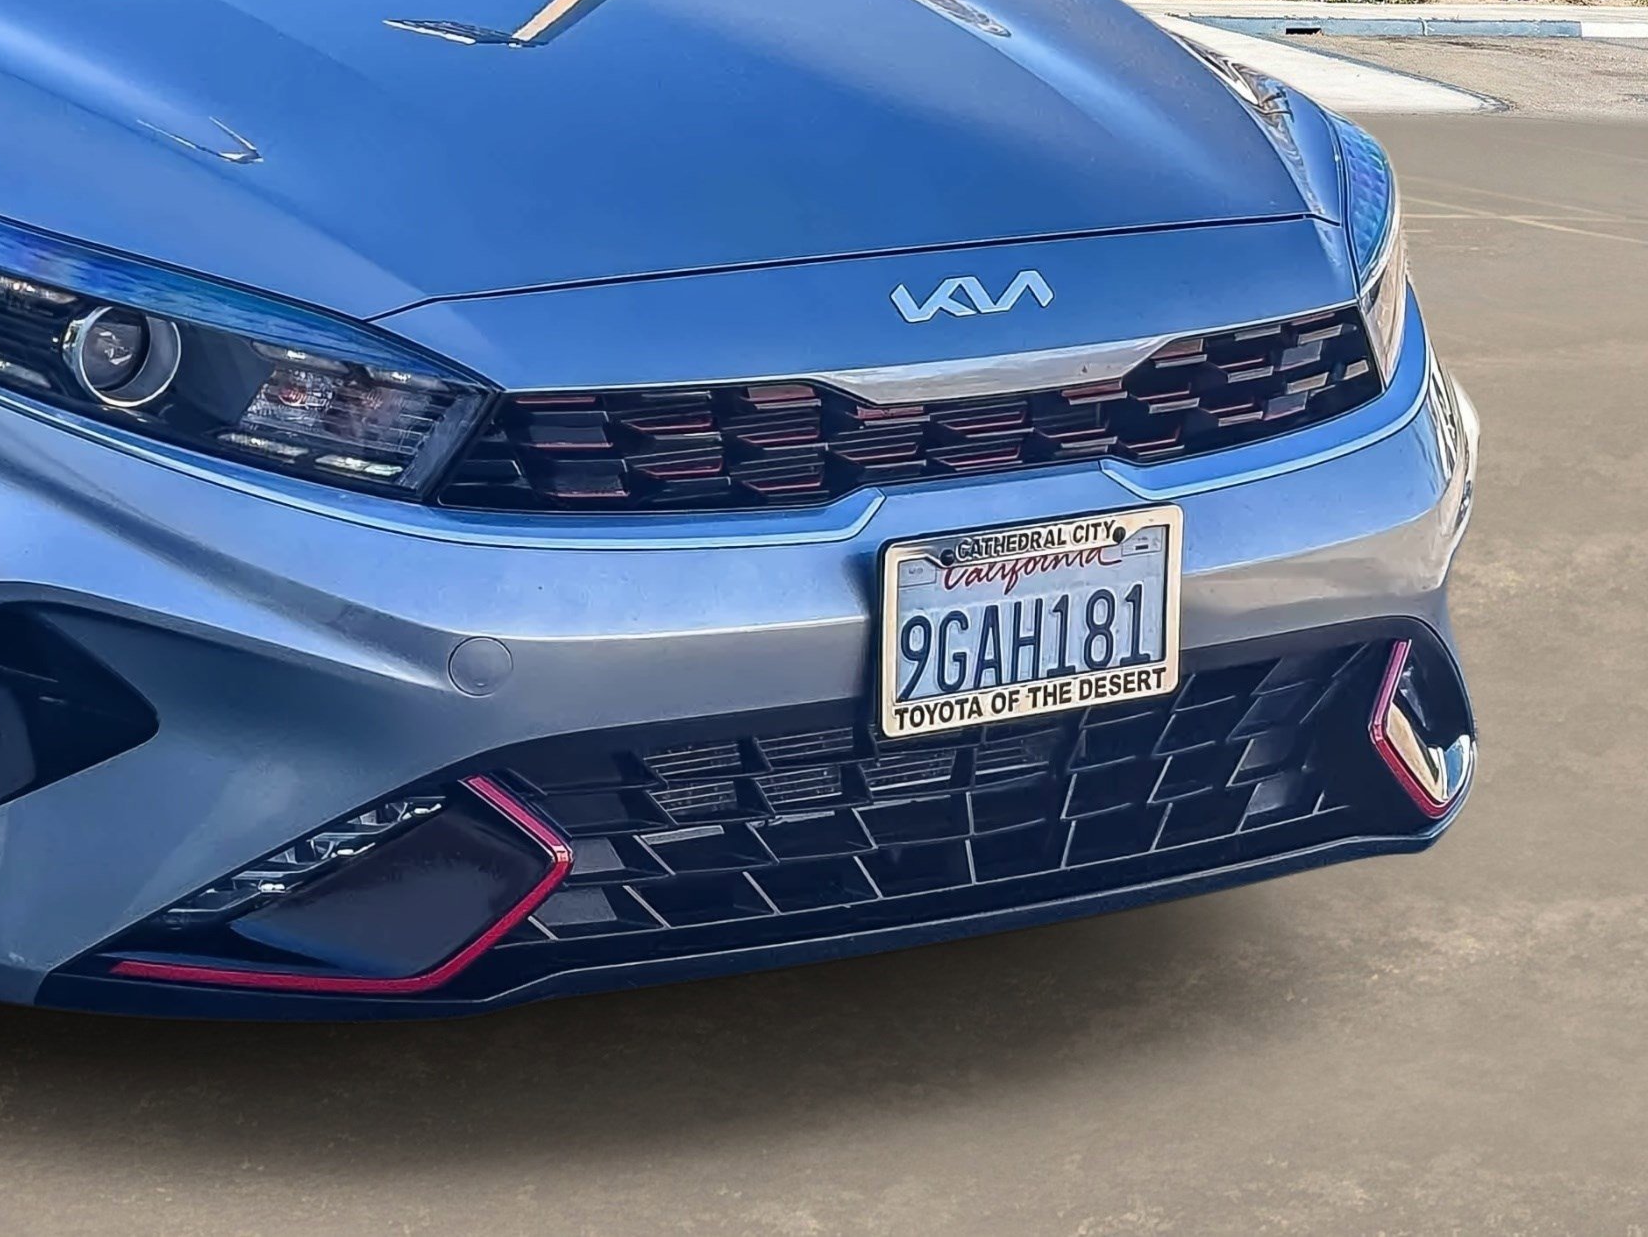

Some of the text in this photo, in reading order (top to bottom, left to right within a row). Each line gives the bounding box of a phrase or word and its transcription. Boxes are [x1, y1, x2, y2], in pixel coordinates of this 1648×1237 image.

[954, 528, 1067, 561] CATHEDRAL
[1072, 519, 1116, 545] CITY
[943, 546, 1122, 595] California
[895, 583, 1152, 702] 9GAH181
[894, 667, 1167, 731] TOYOTA OF THE DESERT
